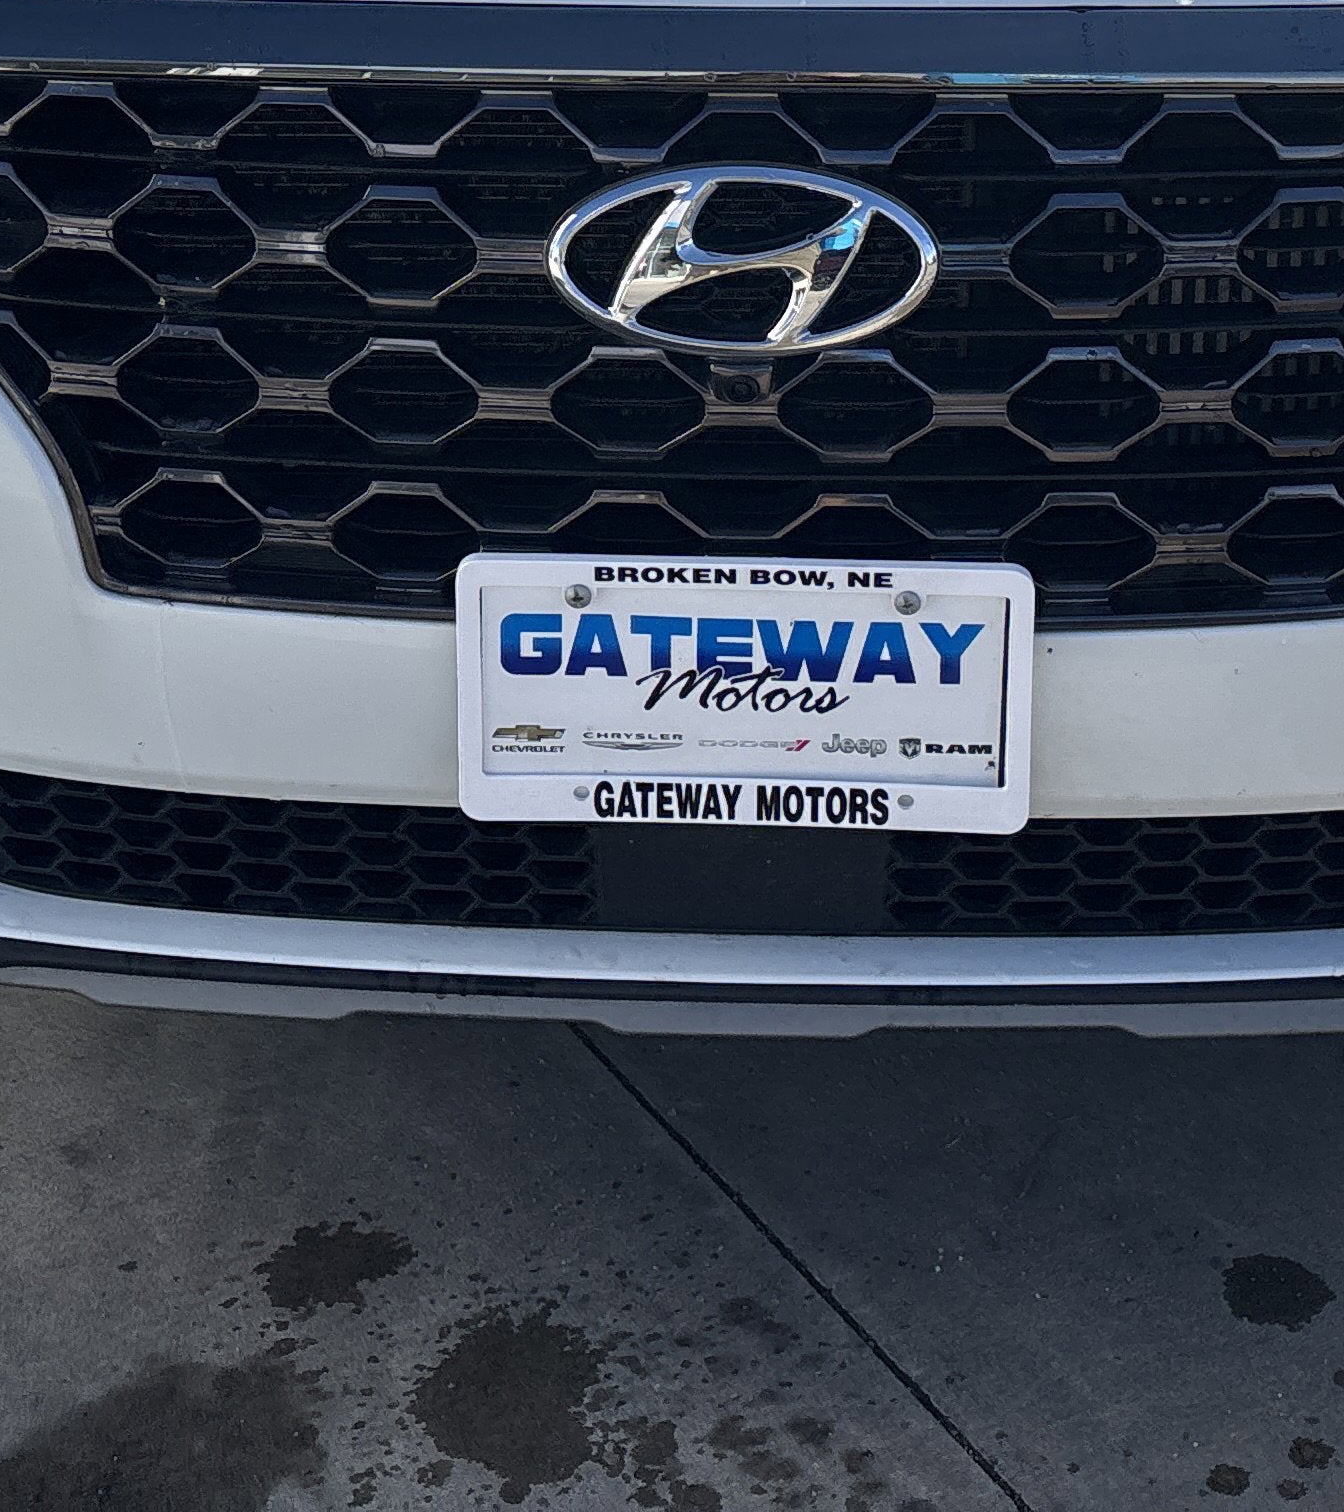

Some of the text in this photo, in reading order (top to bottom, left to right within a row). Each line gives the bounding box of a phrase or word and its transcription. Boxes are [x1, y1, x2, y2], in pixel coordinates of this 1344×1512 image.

[593, 566, 894, 590] BROKEN BOW, NE
[499, 612, 986, 685] GATEWAY
[635, 666, 850, 714] Motors
[492, 744, 566, 753] CHEVROLET
[582, 731, 684, 741] CHRYSLER
[821, 733, 888, 757] Jeep
[925, 743, 993, 755] RAM
[593, 780, 890, 826] GATEWAY MOTORS
